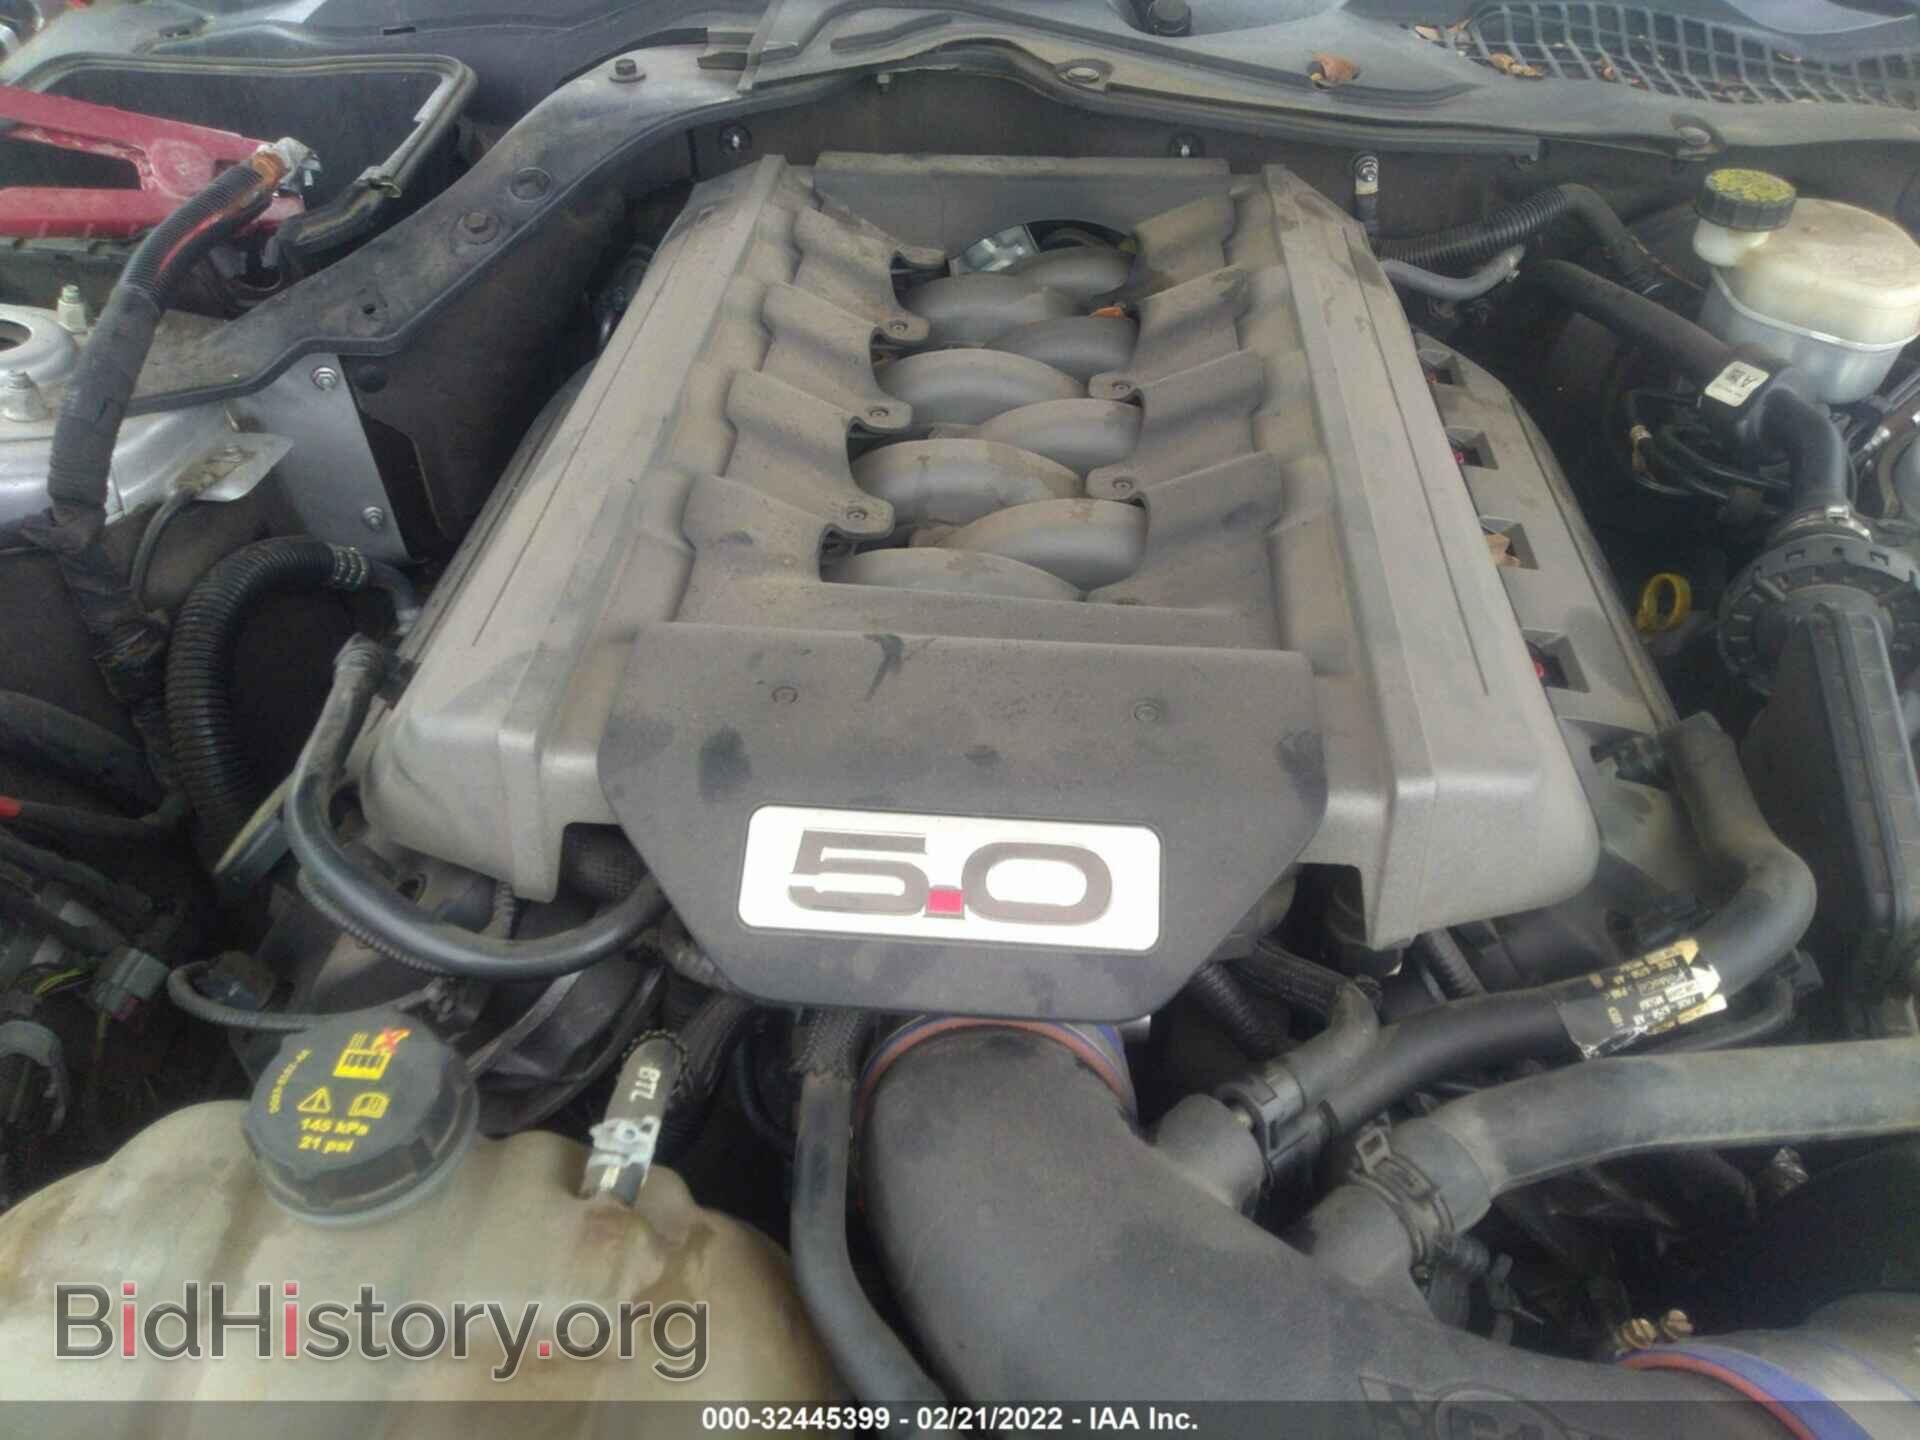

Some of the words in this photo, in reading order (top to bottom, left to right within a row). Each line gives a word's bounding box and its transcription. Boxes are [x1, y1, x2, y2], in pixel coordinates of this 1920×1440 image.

[787, 828, 1113, 927] 5.0
[335, 1120, 370, 1137] kPa
[298, 1135, 322, 1150] 21
[323, 1139, 354, 1154] psi
